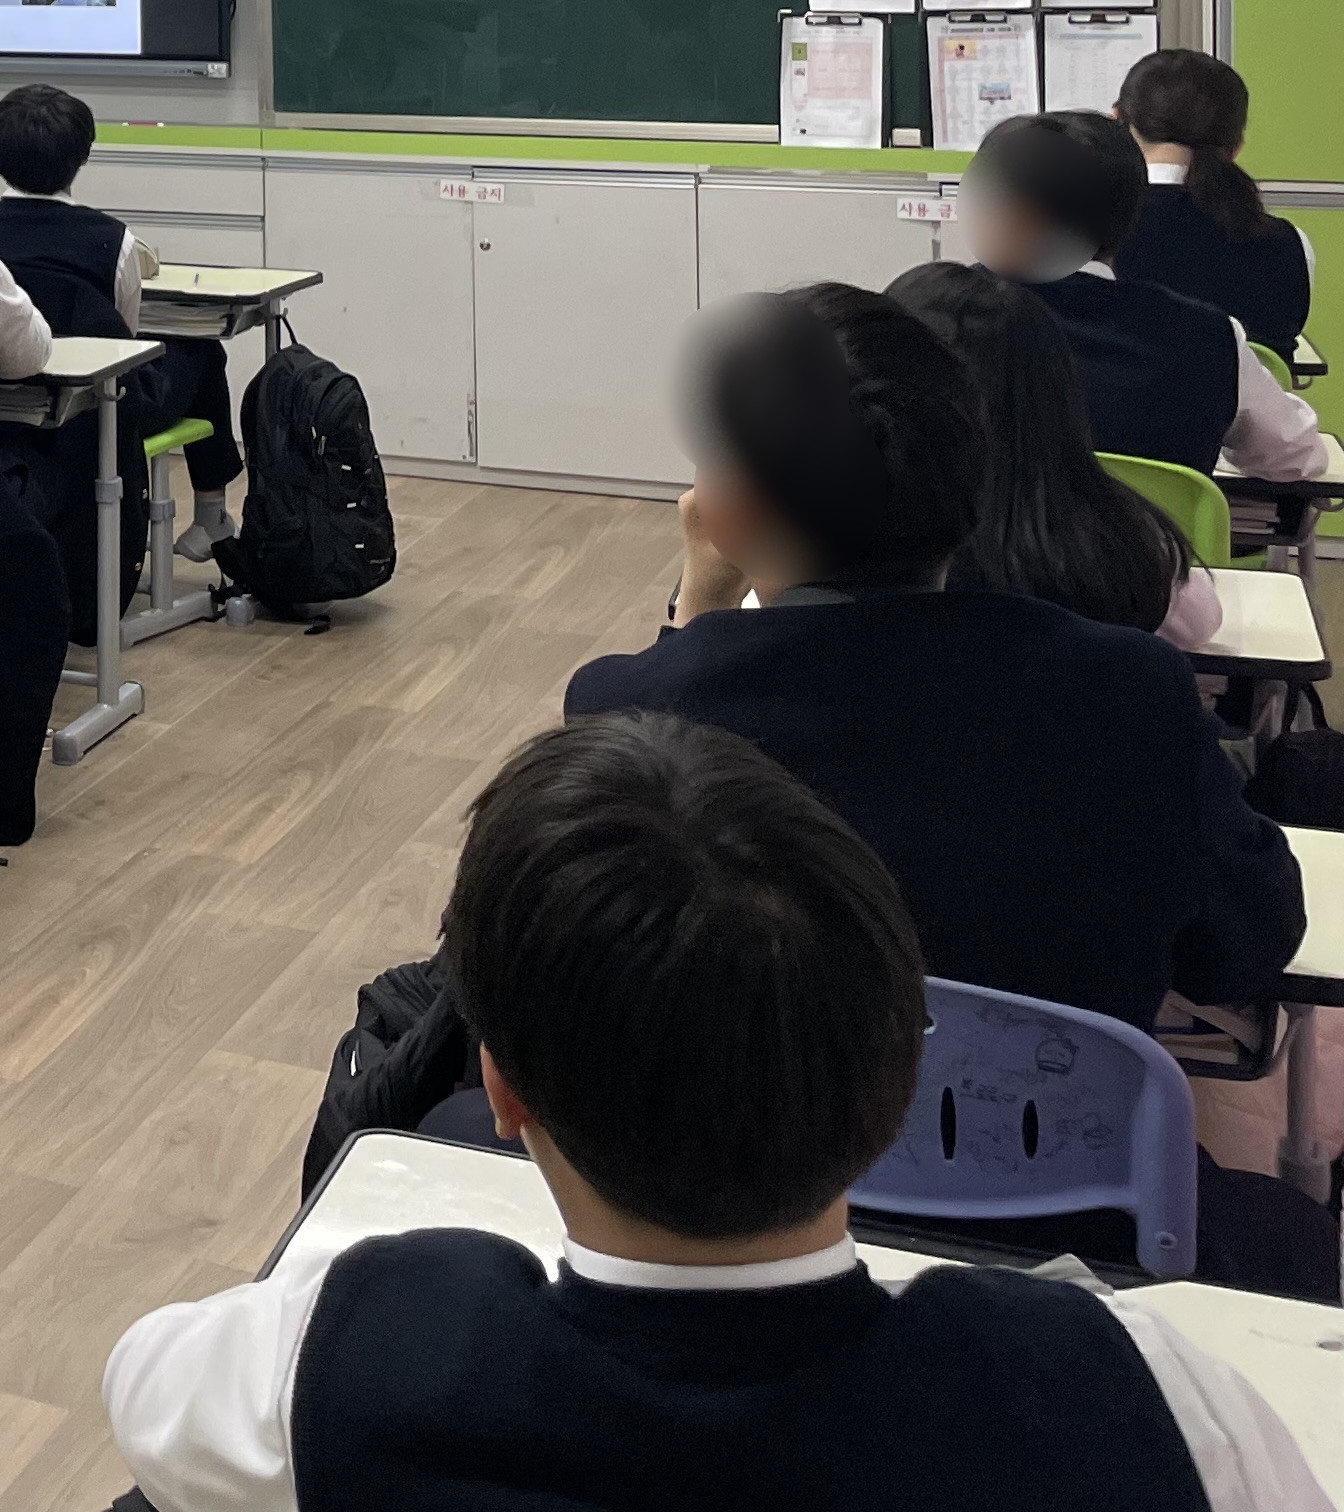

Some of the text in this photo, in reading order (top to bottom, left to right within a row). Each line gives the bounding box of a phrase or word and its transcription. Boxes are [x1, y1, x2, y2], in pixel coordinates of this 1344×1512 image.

[442, 183, 502, 202] 사용 금지
[898, 201, 957, 219] 사용 금
